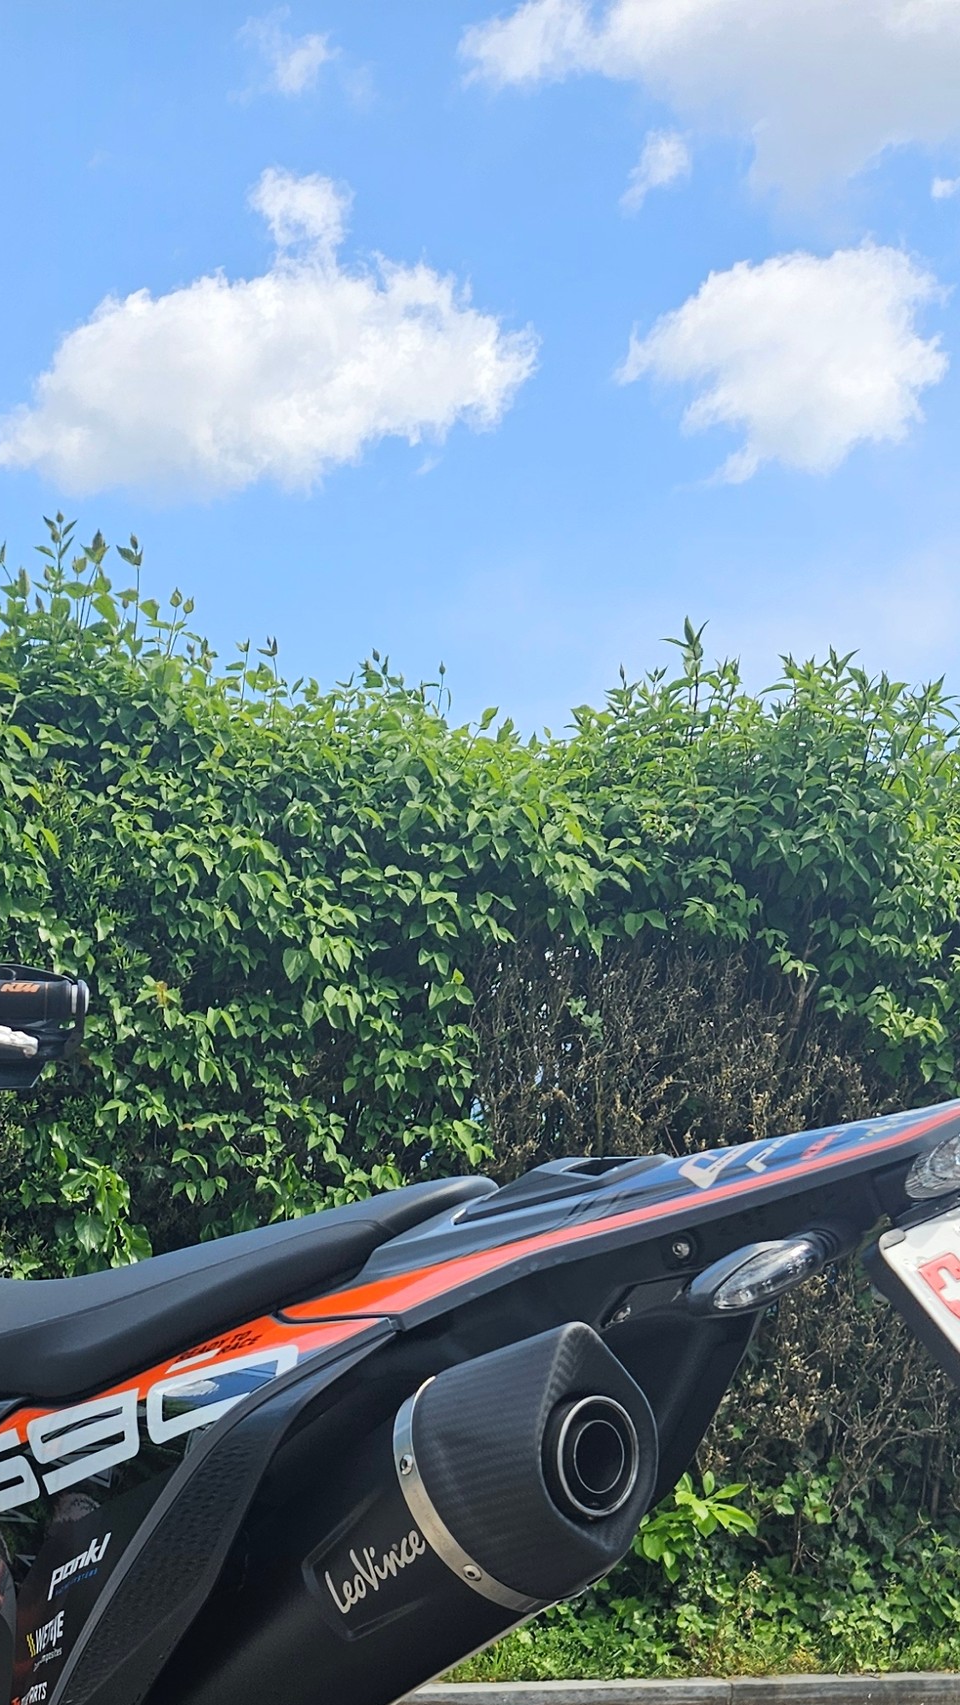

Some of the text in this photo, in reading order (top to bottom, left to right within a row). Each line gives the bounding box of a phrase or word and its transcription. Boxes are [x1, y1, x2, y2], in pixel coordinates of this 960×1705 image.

[0, 982, 40, 993] KTM
[217, 1335, 262, 1356] RACE
[325, 1530, 426, 1614] LeoVince
